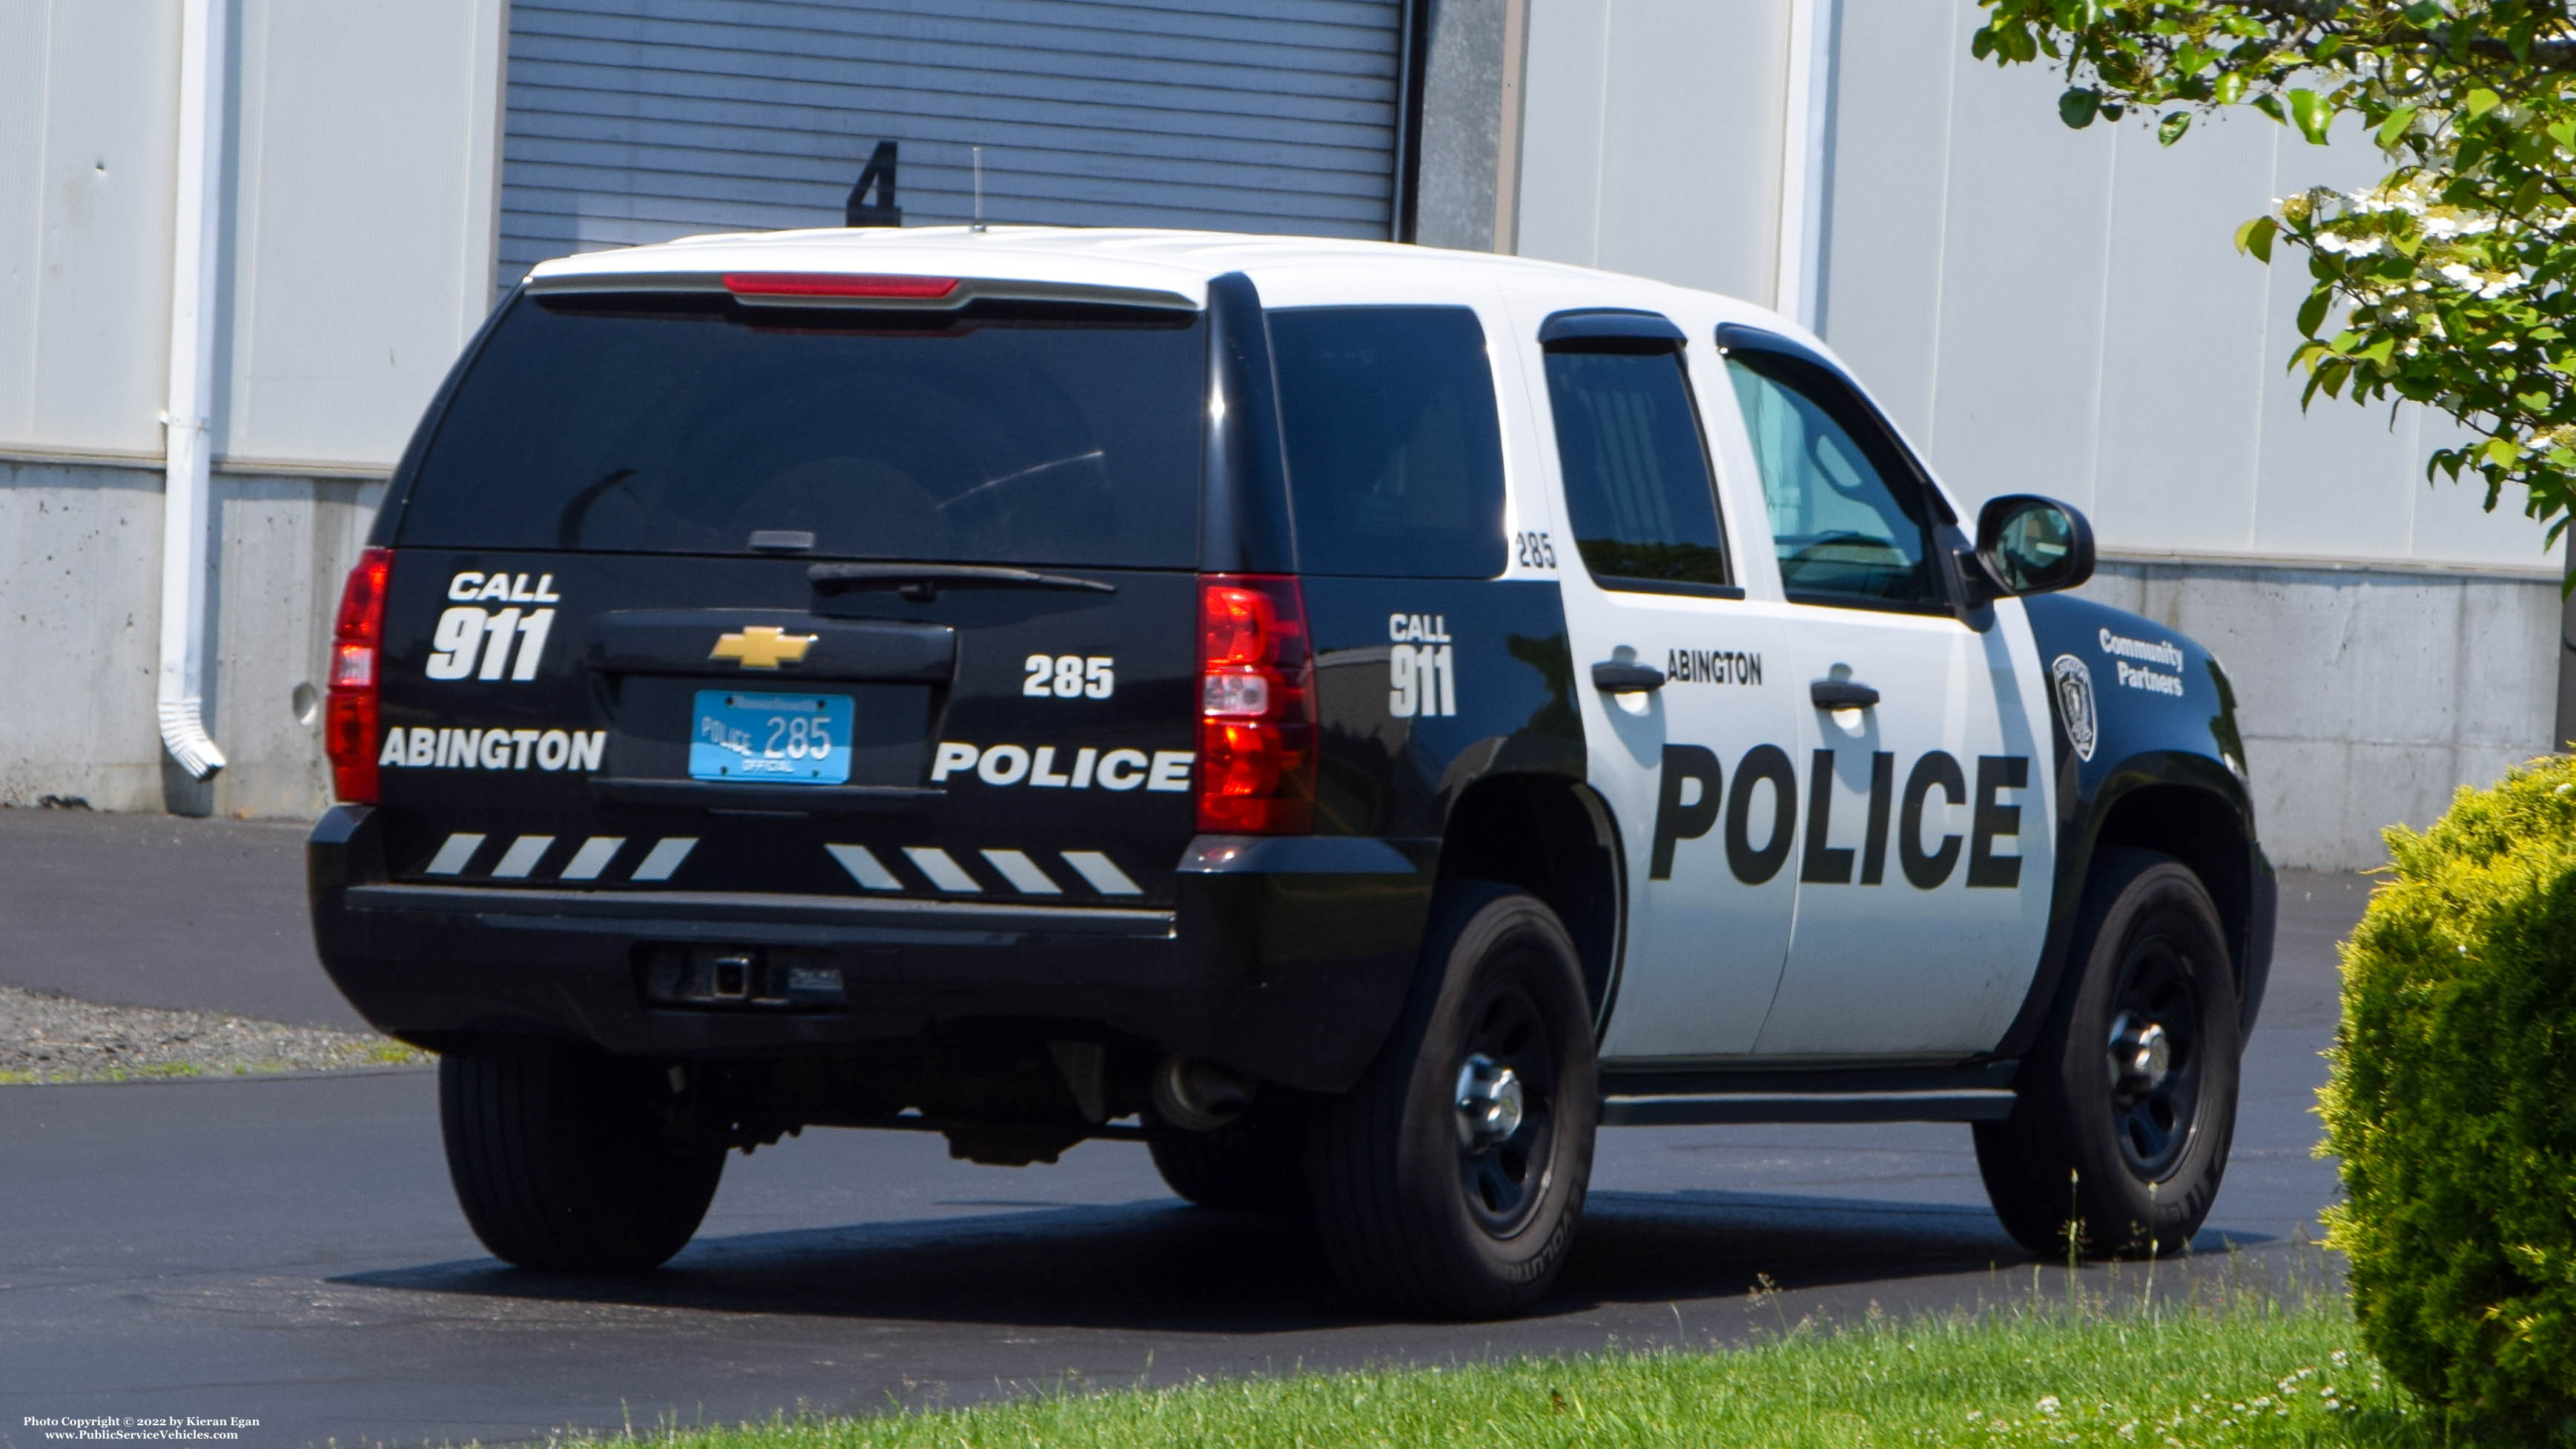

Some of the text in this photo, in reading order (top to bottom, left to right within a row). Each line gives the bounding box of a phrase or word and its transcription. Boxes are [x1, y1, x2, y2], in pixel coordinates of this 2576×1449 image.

[846, 140, 902, 228] 4
[1516, 532, 1556, 570] 285
[448, 572, 561, 603] CALL
[426, 607, 557, 681] 911
[1389, 613, 1451, 643] CALL
[2099, 628, 2184, 673] Community
[1023, 654, 1115, 700] 285
[1389, 644, 1457, 718] 911
[1666, 649, 1763, 687] ABINGTON
[2117, 661, 2184, 697] Partners
[378, 727, 607, 771] ABINGTON
[701, 716, 833, 761] POLICE 285
[931, 742, 1197, 793] POLICE
[1649, 743, 2030, 891] POLICE
